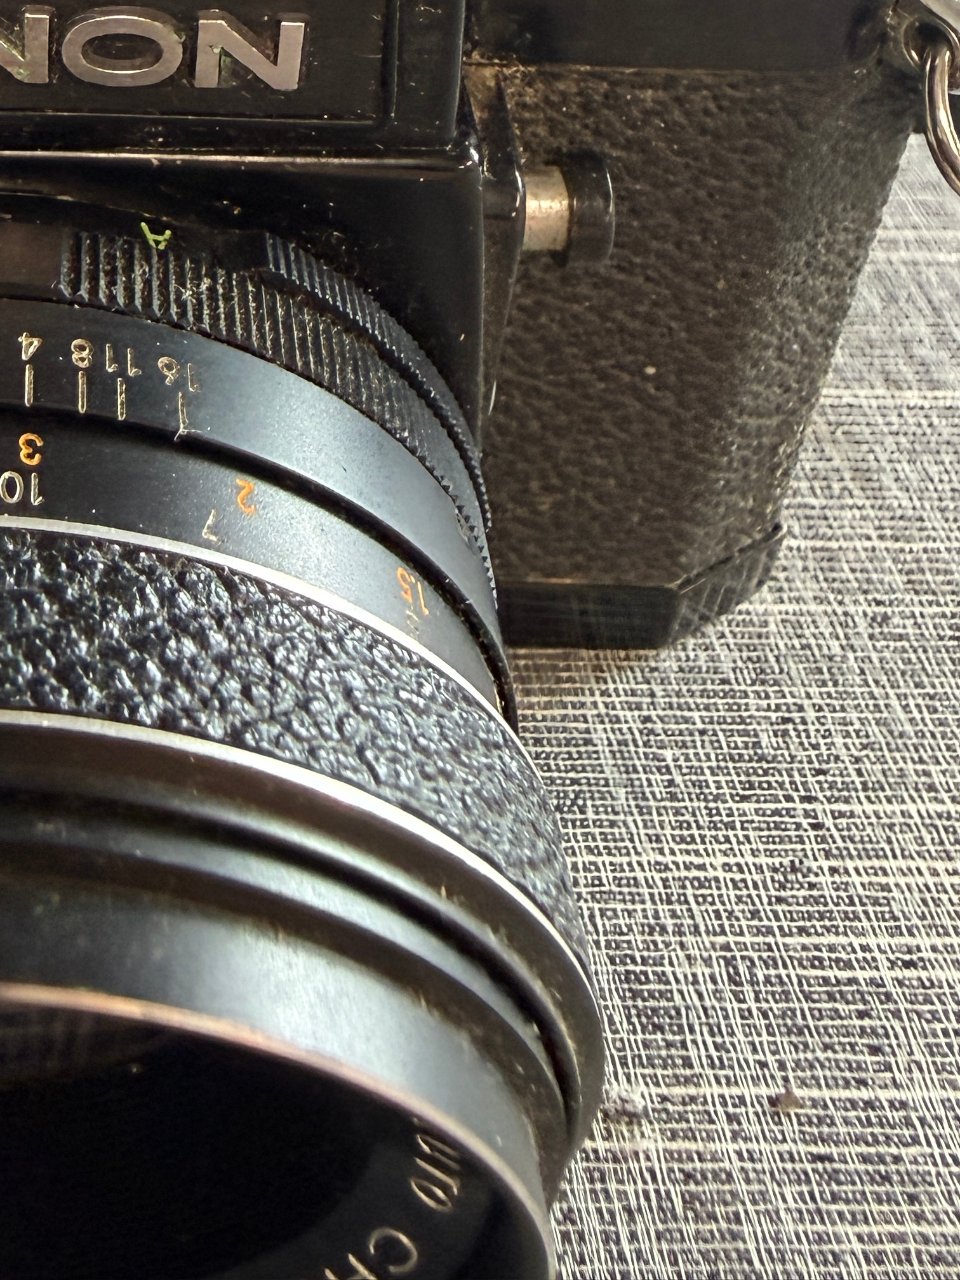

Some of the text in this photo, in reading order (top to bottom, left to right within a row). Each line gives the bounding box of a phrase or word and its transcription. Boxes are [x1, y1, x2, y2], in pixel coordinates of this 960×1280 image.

[18, 331, 43, 362] 4
[70, 338, 94, 369] 8
[106, 342, 142, 377] 11
[157, 356, 201, 393] 16
[18, 432, 44, 467] 3
[235, 478, 258, 516] 2
